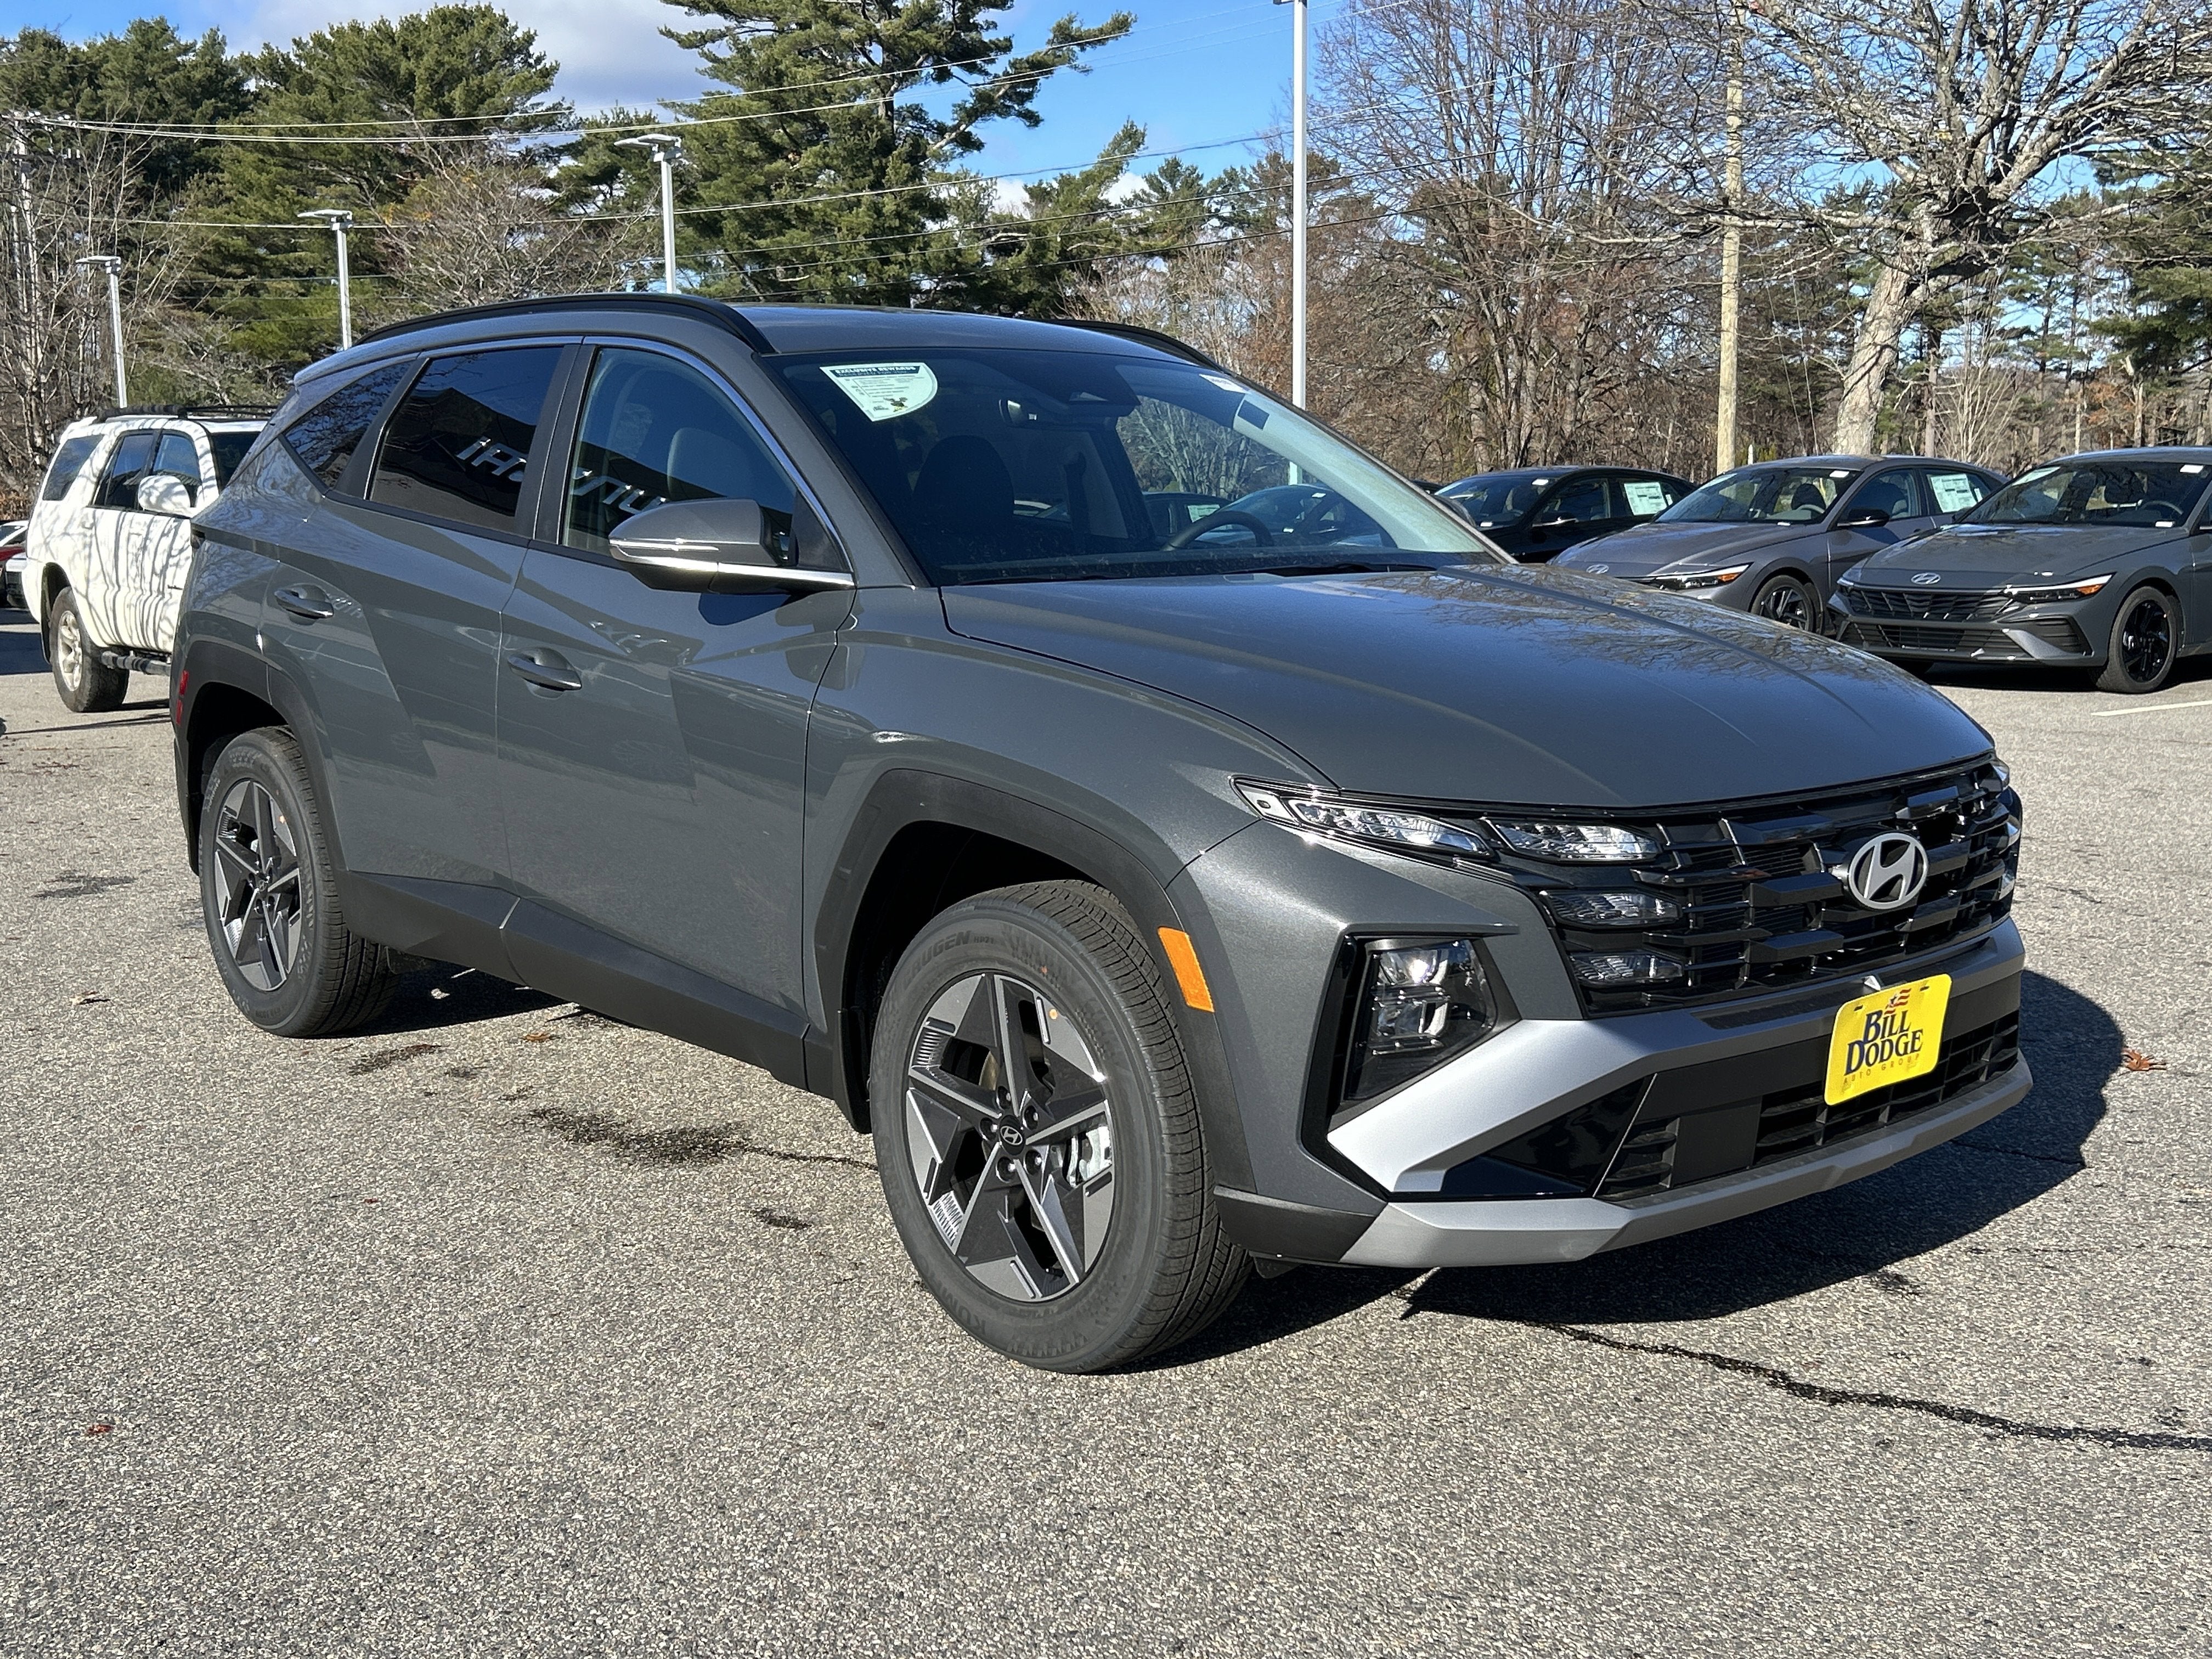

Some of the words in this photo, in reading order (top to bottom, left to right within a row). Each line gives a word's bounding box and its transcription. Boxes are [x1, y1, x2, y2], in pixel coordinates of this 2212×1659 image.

[1864, 1010, 1912, 1045] BILL
[1843, 1069, 1871, 1084] AUTO
[1882, 1054, 1920, 1070] GROUP
[1844, 1029, 1924, 1076] DODGE
